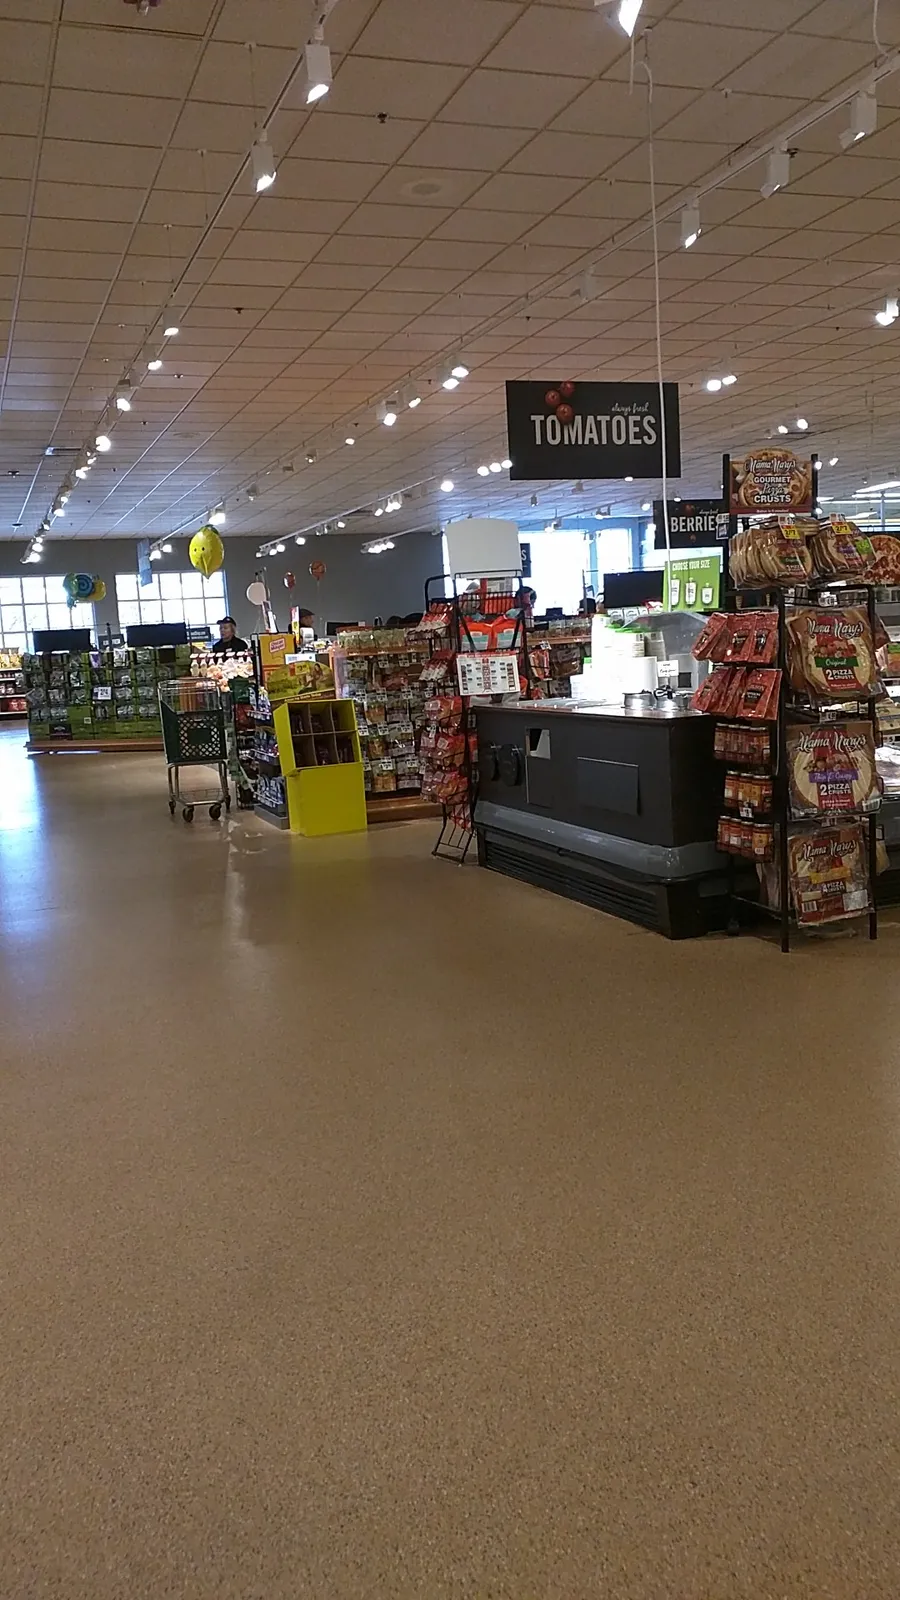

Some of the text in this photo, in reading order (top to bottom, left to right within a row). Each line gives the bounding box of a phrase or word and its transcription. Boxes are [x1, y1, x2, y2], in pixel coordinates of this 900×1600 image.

[611, 402, 649, 416] always fresh
[530, 415, 657, 445] TOMATOES
[754, 495, 791, 503] CRUSTS
[670, 516, 717, 532] BERRIE
[672, 561, 688, 572] CHOOSE
[701, 559, 711, 569] SIZE
[825, 658, 847, 667] Original
[825, 669, 834, 680] 2
[820, 784, 828, 796] 2
